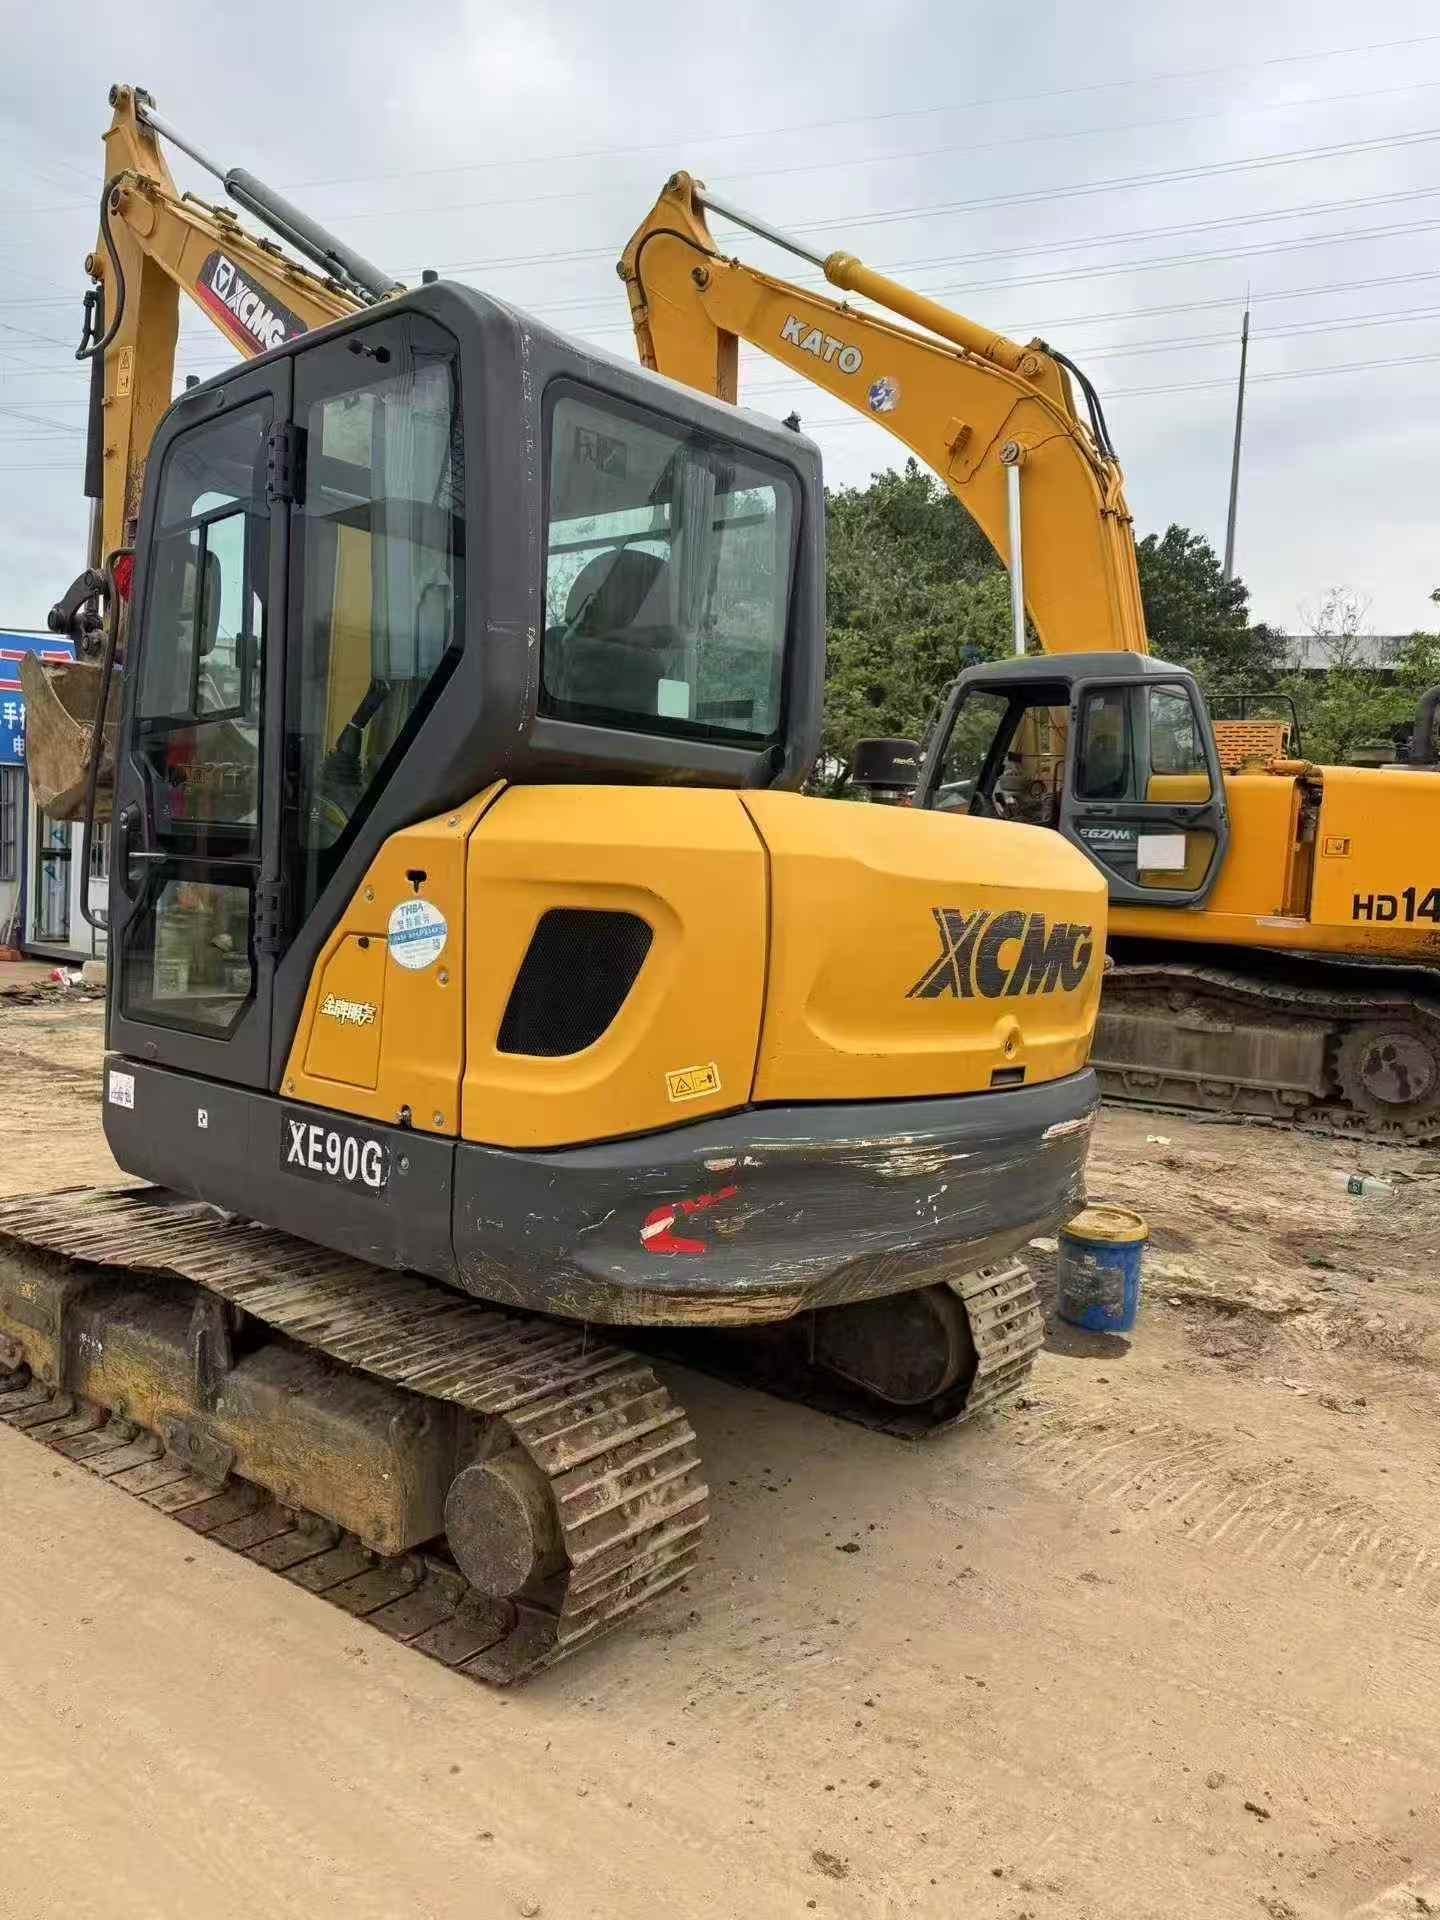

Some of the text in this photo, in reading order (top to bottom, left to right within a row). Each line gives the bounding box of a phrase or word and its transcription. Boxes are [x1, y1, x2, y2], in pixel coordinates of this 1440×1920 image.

[224, 277, 285, 351] XCMG
[780, 313, 863, 374] KATO
[1353, 887, 1440, 922] HD14
[905, 907, 1093, 998] XCMG
[287, 1119, 384, 1188] XE90G
